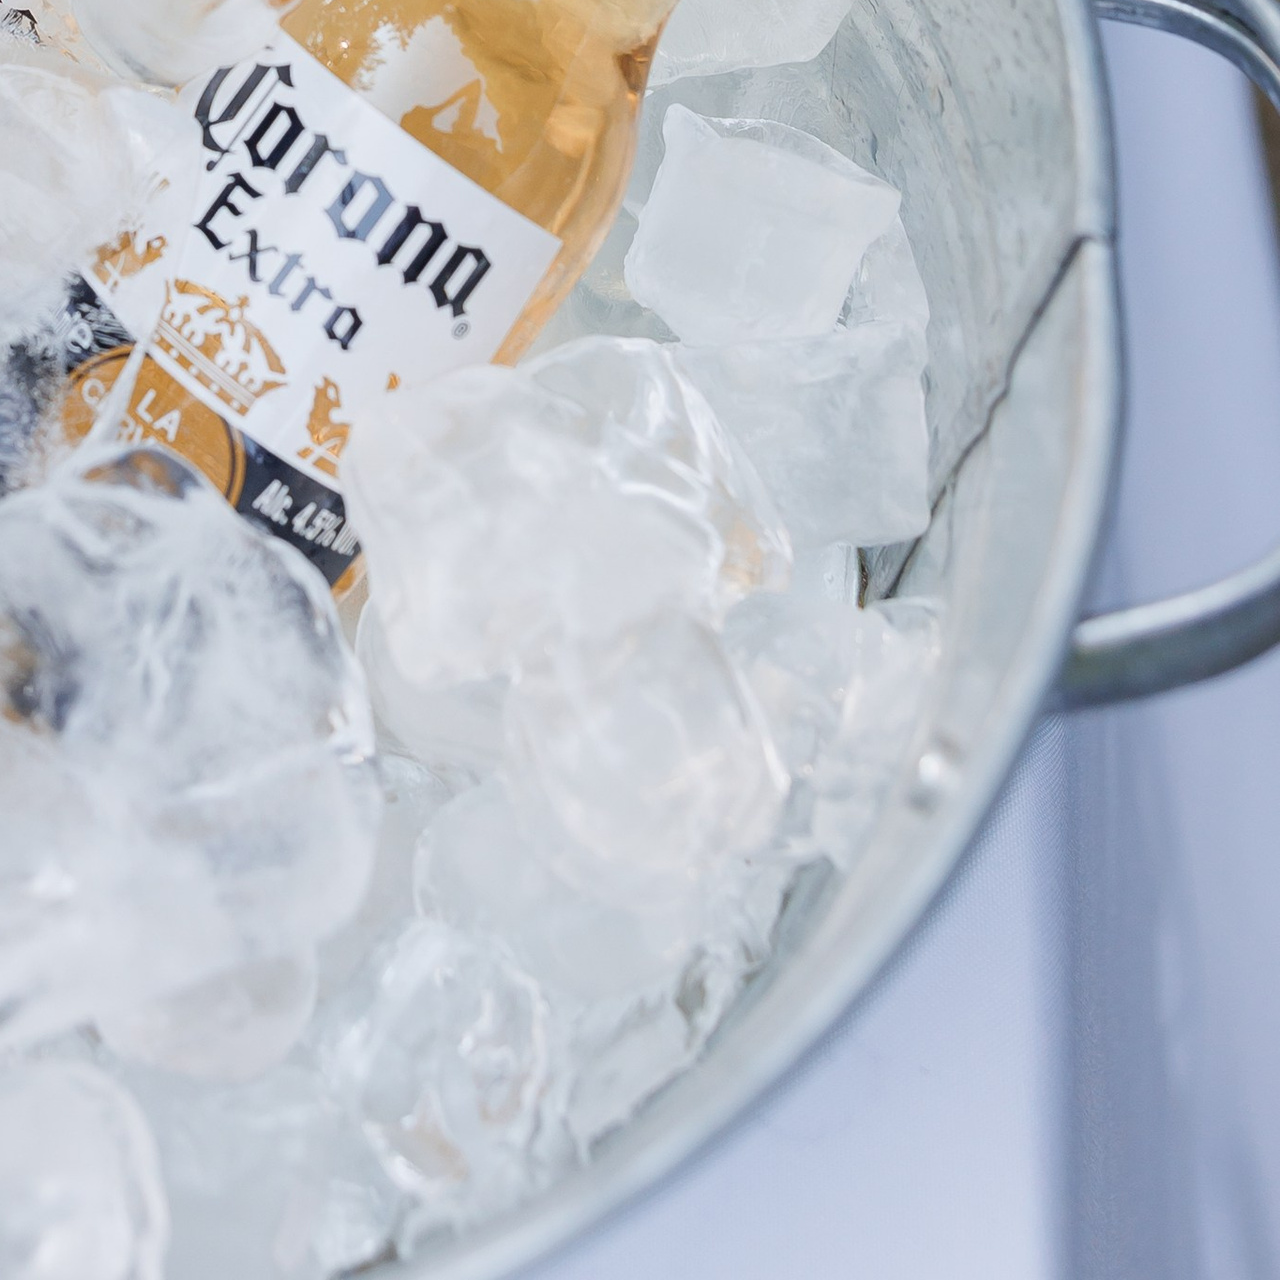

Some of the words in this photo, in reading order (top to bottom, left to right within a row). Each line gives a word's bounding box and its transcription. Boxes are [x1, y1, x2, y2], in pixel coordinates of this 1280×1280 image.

[193, 171, 363, 351] Extra
[194, 63, 491, 317] Corona
[135, 388, 182, 443] LA
